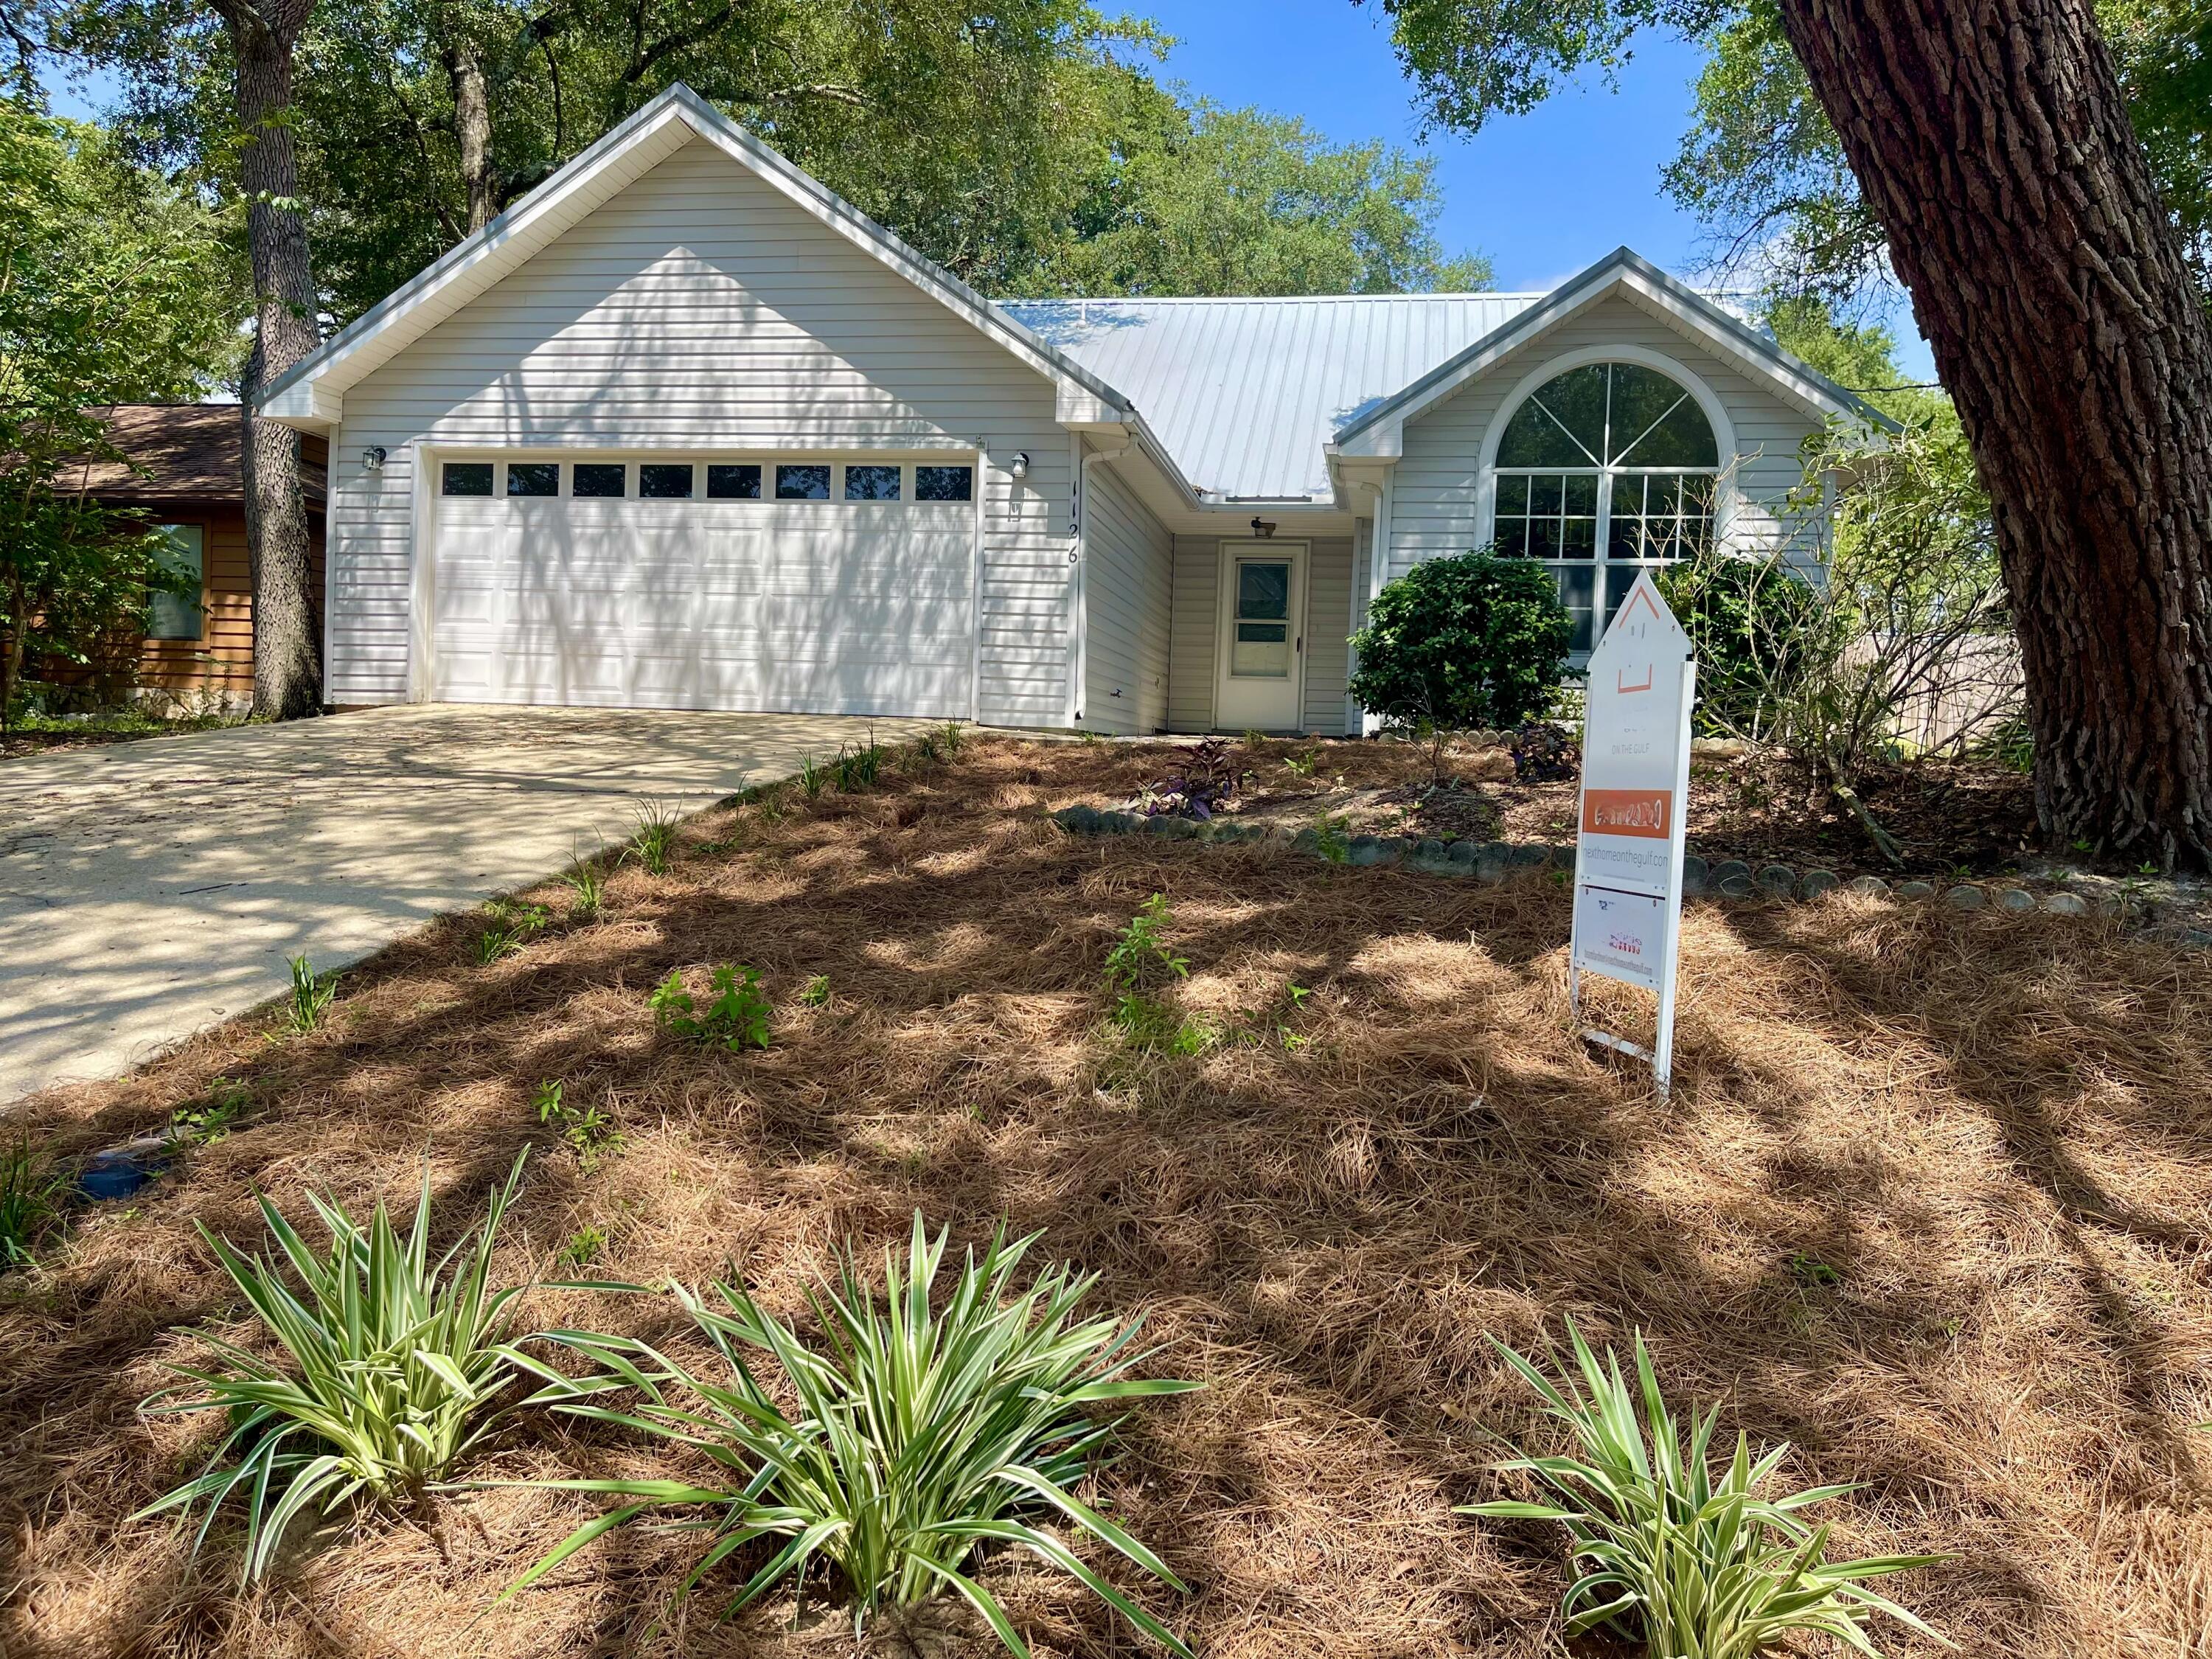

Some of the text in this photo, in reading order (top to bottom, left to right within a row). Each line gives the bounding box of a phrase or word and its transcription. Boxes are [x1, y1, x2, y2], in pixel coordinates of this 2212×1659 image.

[1068, 481, 1078, 563] 1126
[1611, 742, 1650, 755] ON THE GULF
